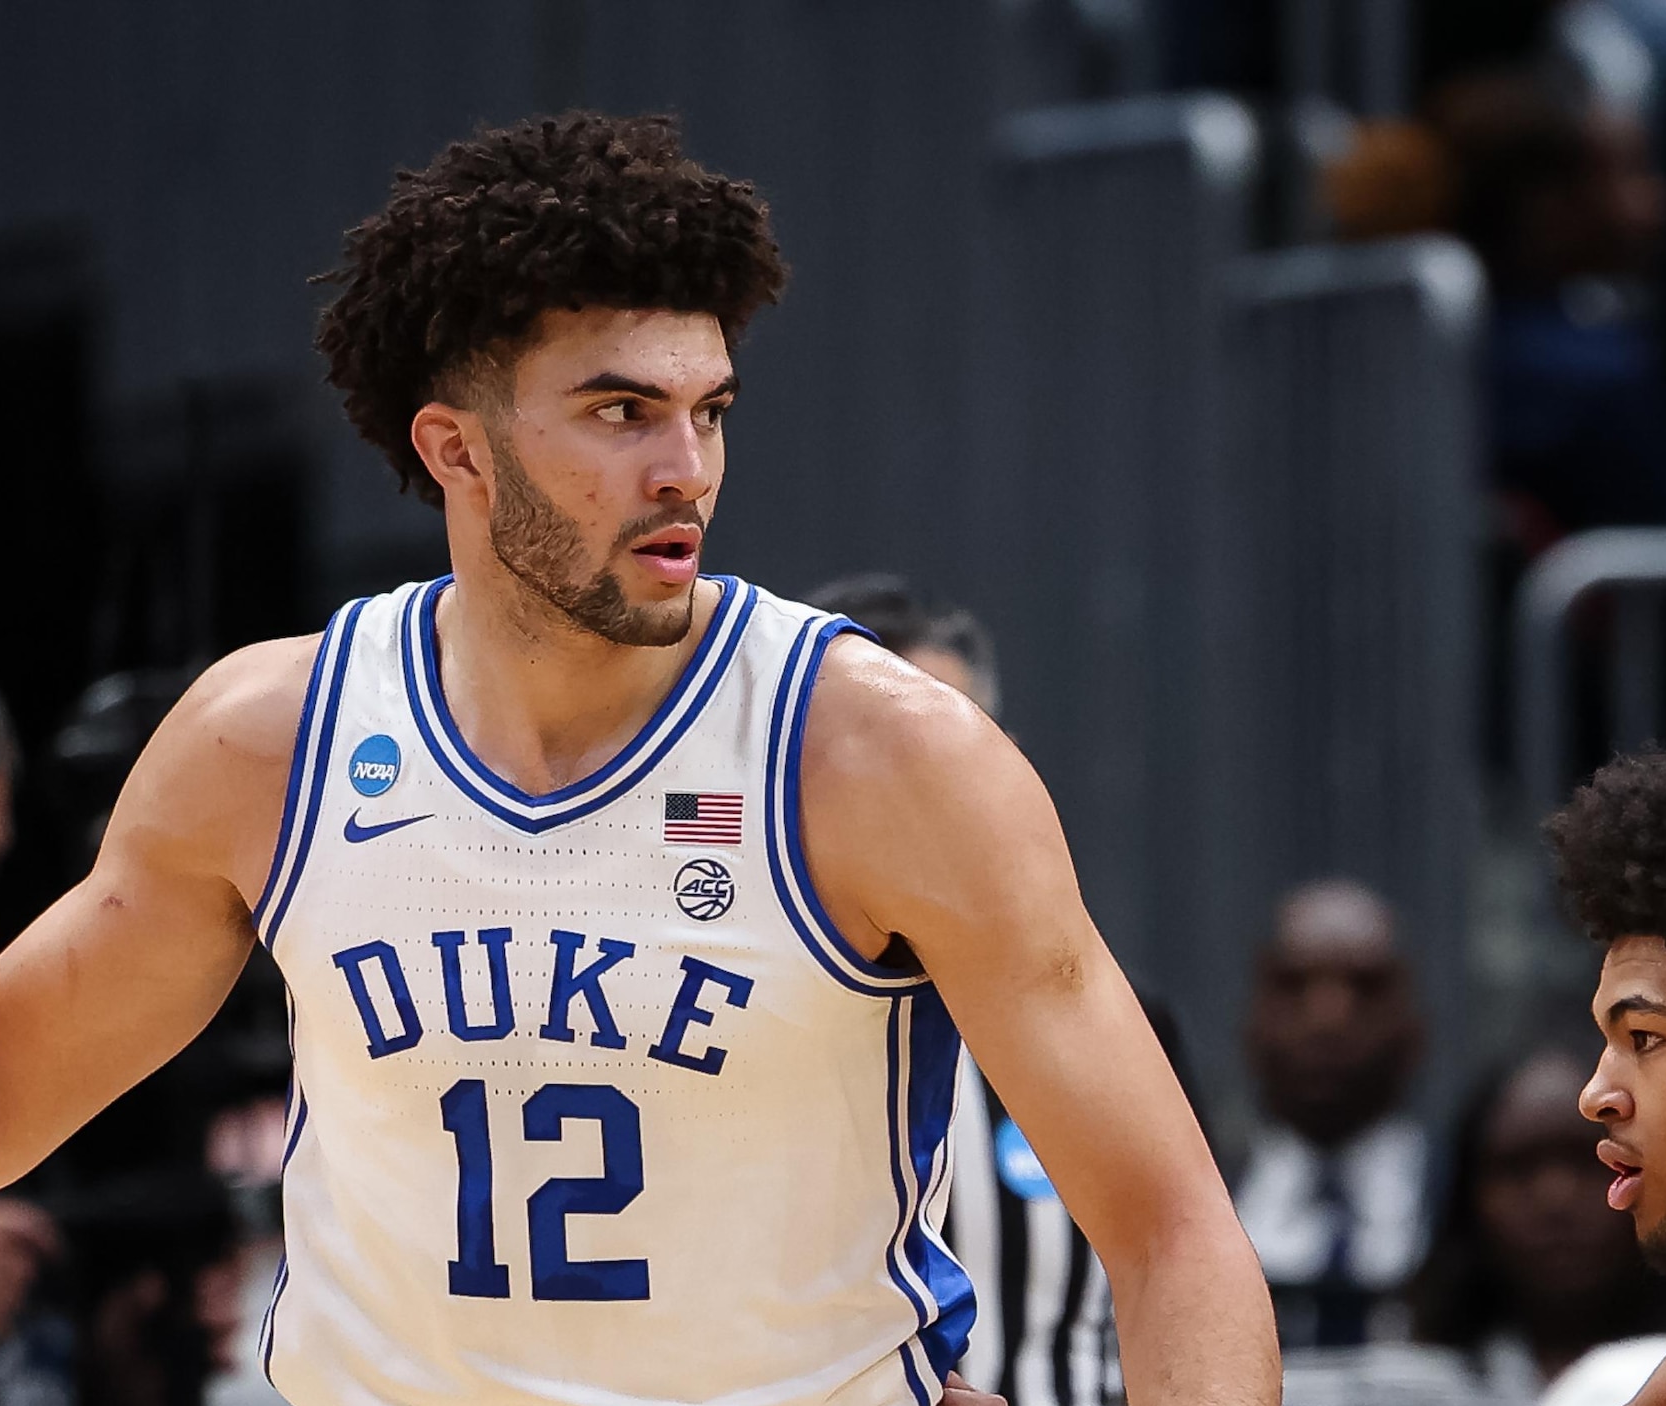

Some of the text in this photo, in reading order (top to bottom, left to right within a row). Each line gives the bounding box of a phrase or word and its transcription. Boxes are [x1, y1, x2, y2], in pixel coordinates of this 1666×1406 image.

[354, 761, 395, 780] NCAA
[681, 879, 732, 898] ACC
[332, 927, 754, 1076] DUKE
[439, 1079, 650, 1301] 12
